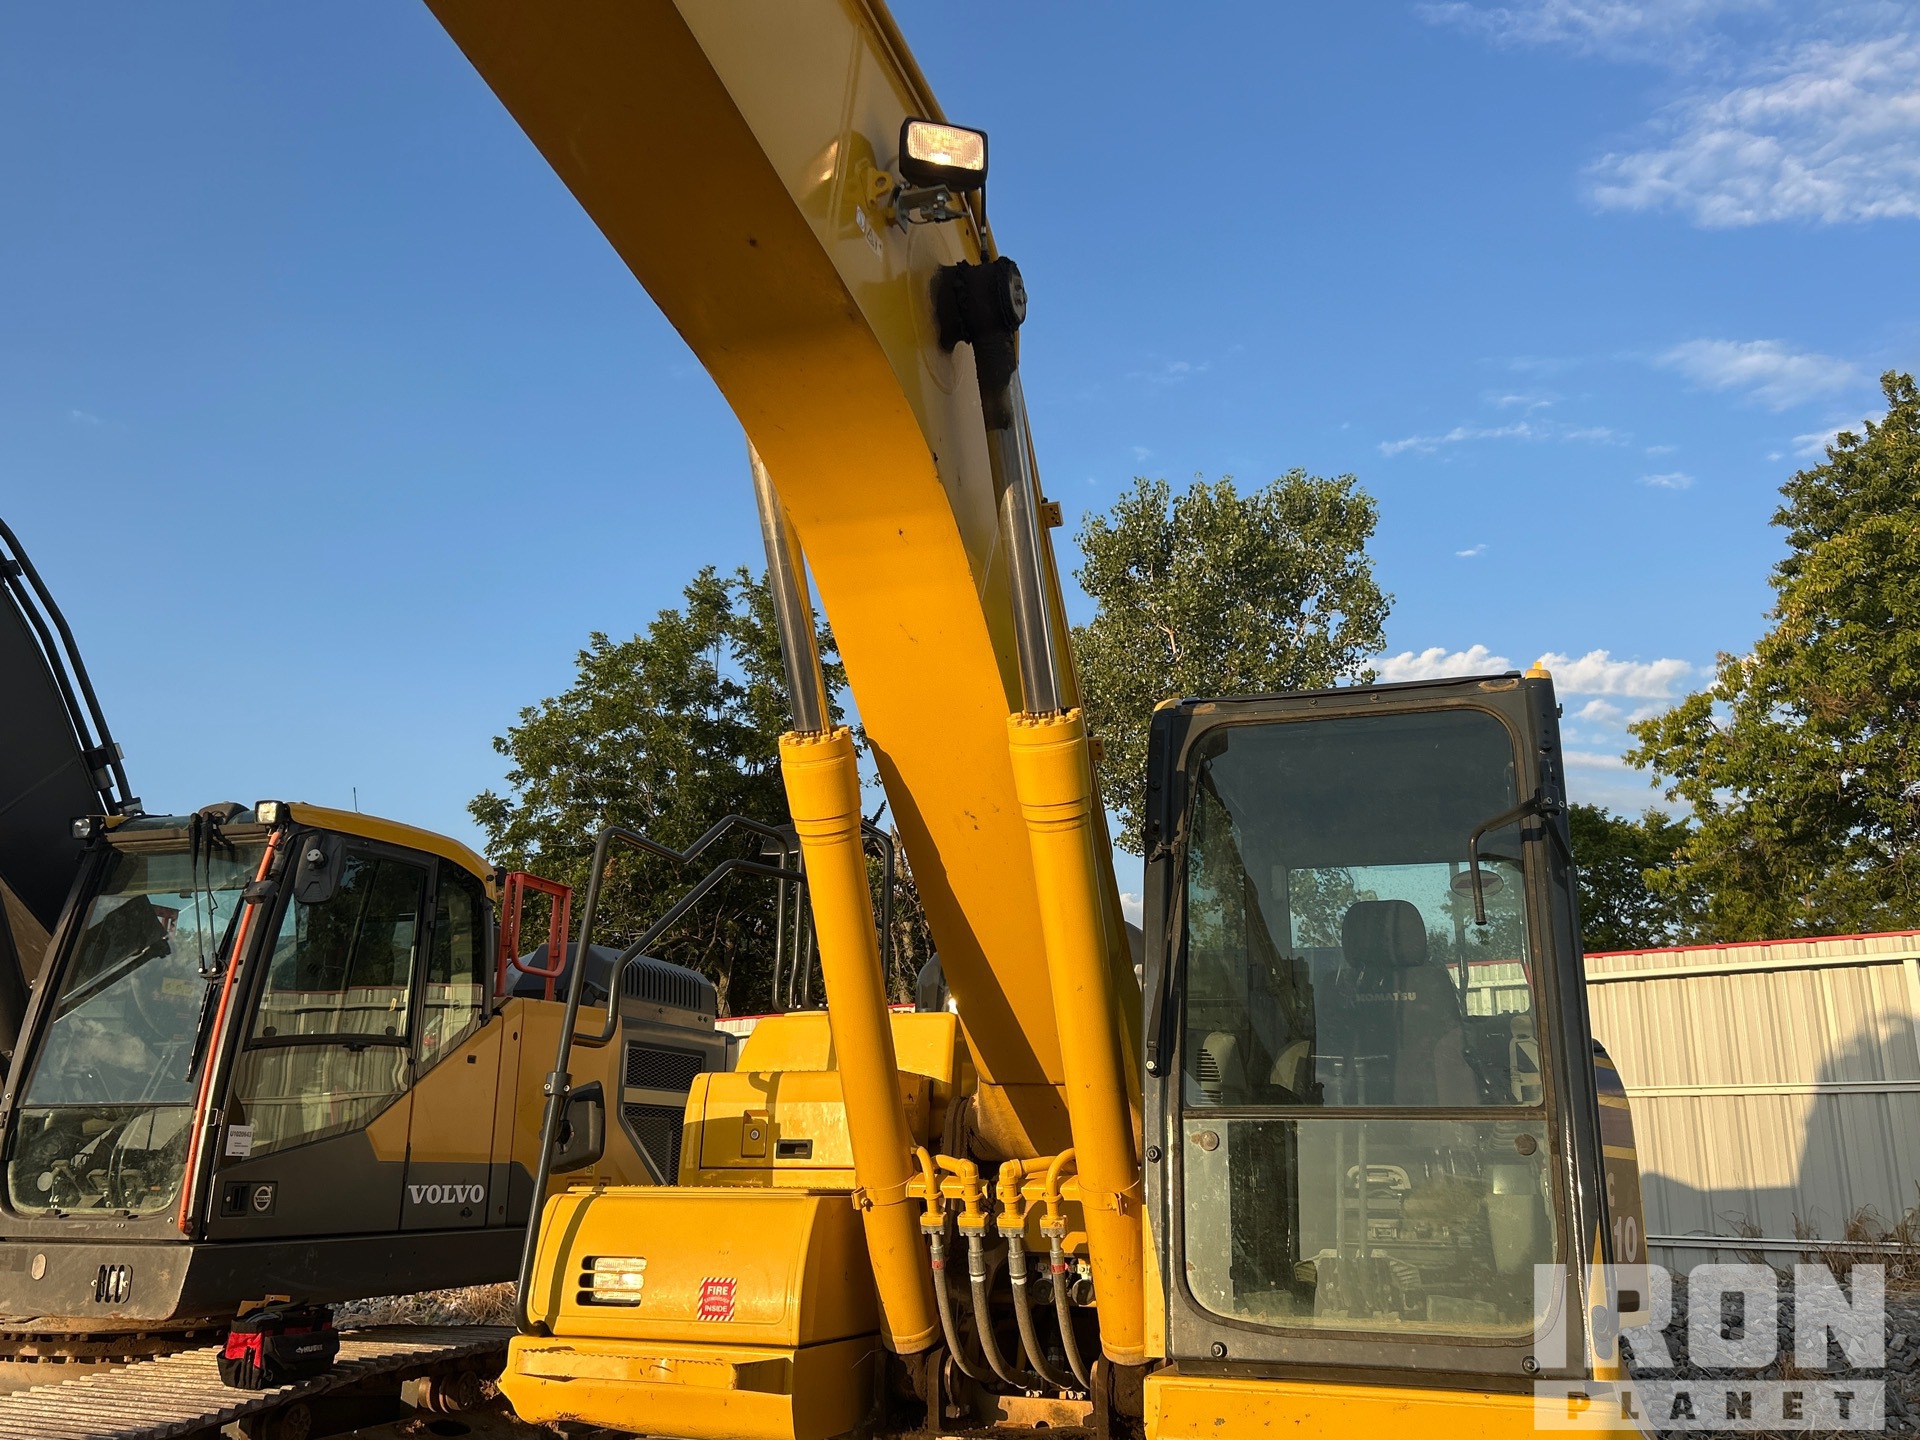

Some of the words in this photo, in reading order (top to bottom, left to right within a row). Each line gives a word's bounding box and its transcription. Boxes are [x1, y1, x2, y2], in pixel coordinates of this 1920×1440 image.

[408, 1184, 485, 1204] VOLVO
[707, 1285, 729, 1296] FIRE
[704, 1304, 728, 1313] INSIDE
